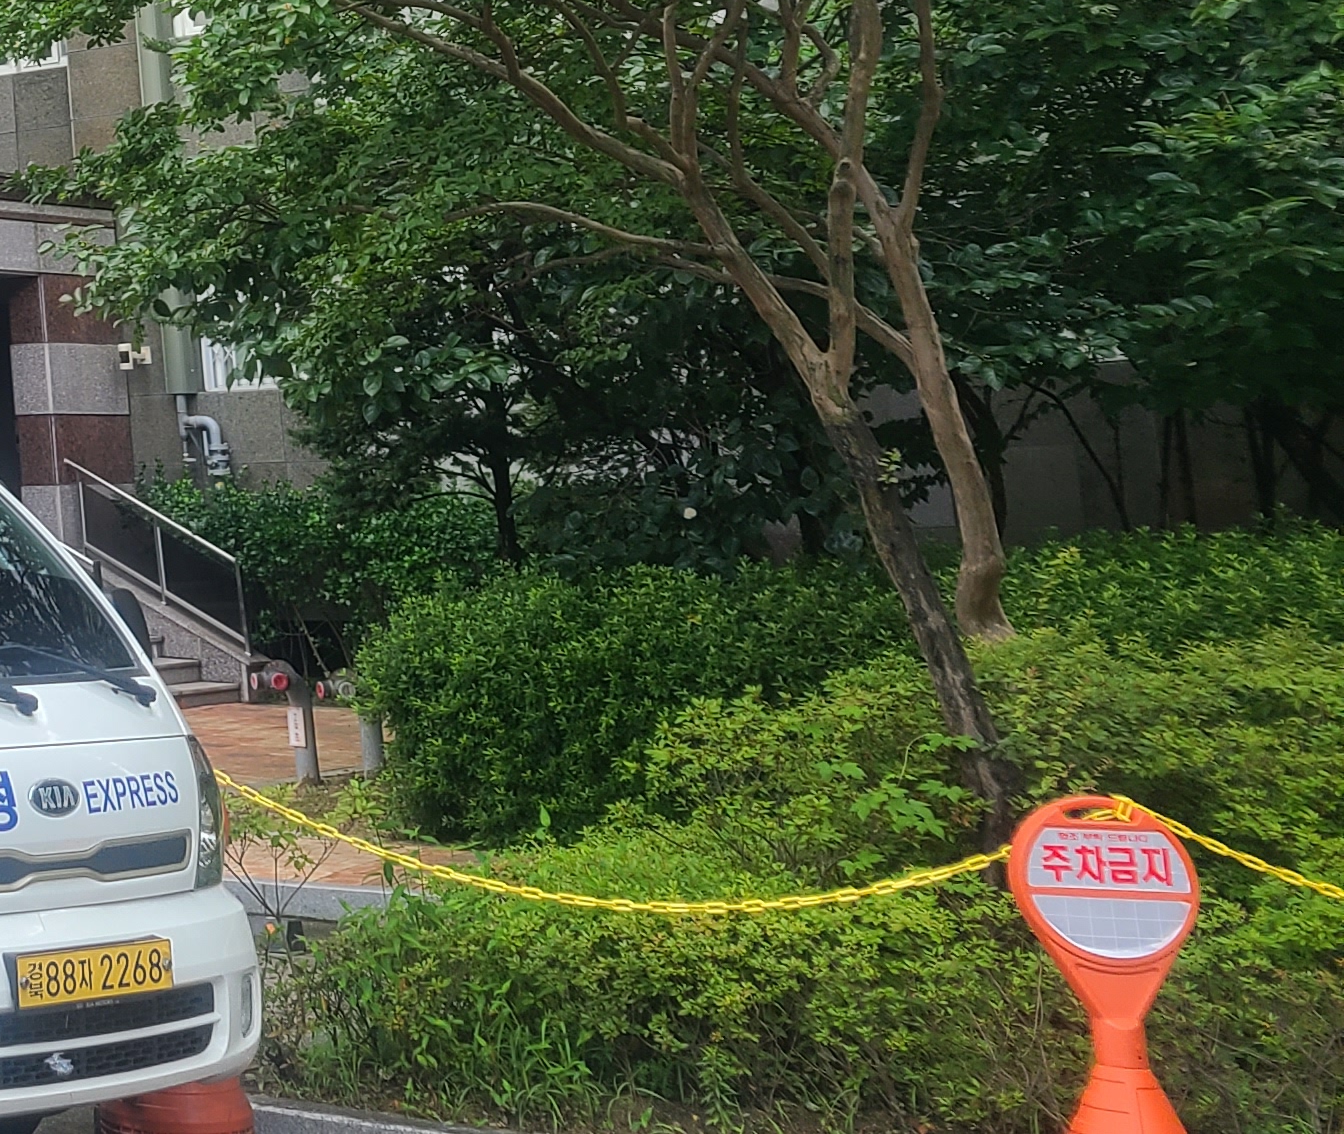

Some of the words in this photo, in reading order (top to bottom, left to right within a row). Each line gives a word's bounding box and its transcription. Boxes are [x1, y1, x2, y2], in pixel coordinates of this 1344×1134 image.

[38, 786, 78, 810] KIA
[82, 771, 179, 814] EXPRESS
[1041, 845, 1174, 886] 주차금지
[28, 961, 43, 1000] 경북
[46, 957, 93, 997] 88자
[100, 948, 163, 991] 2268
